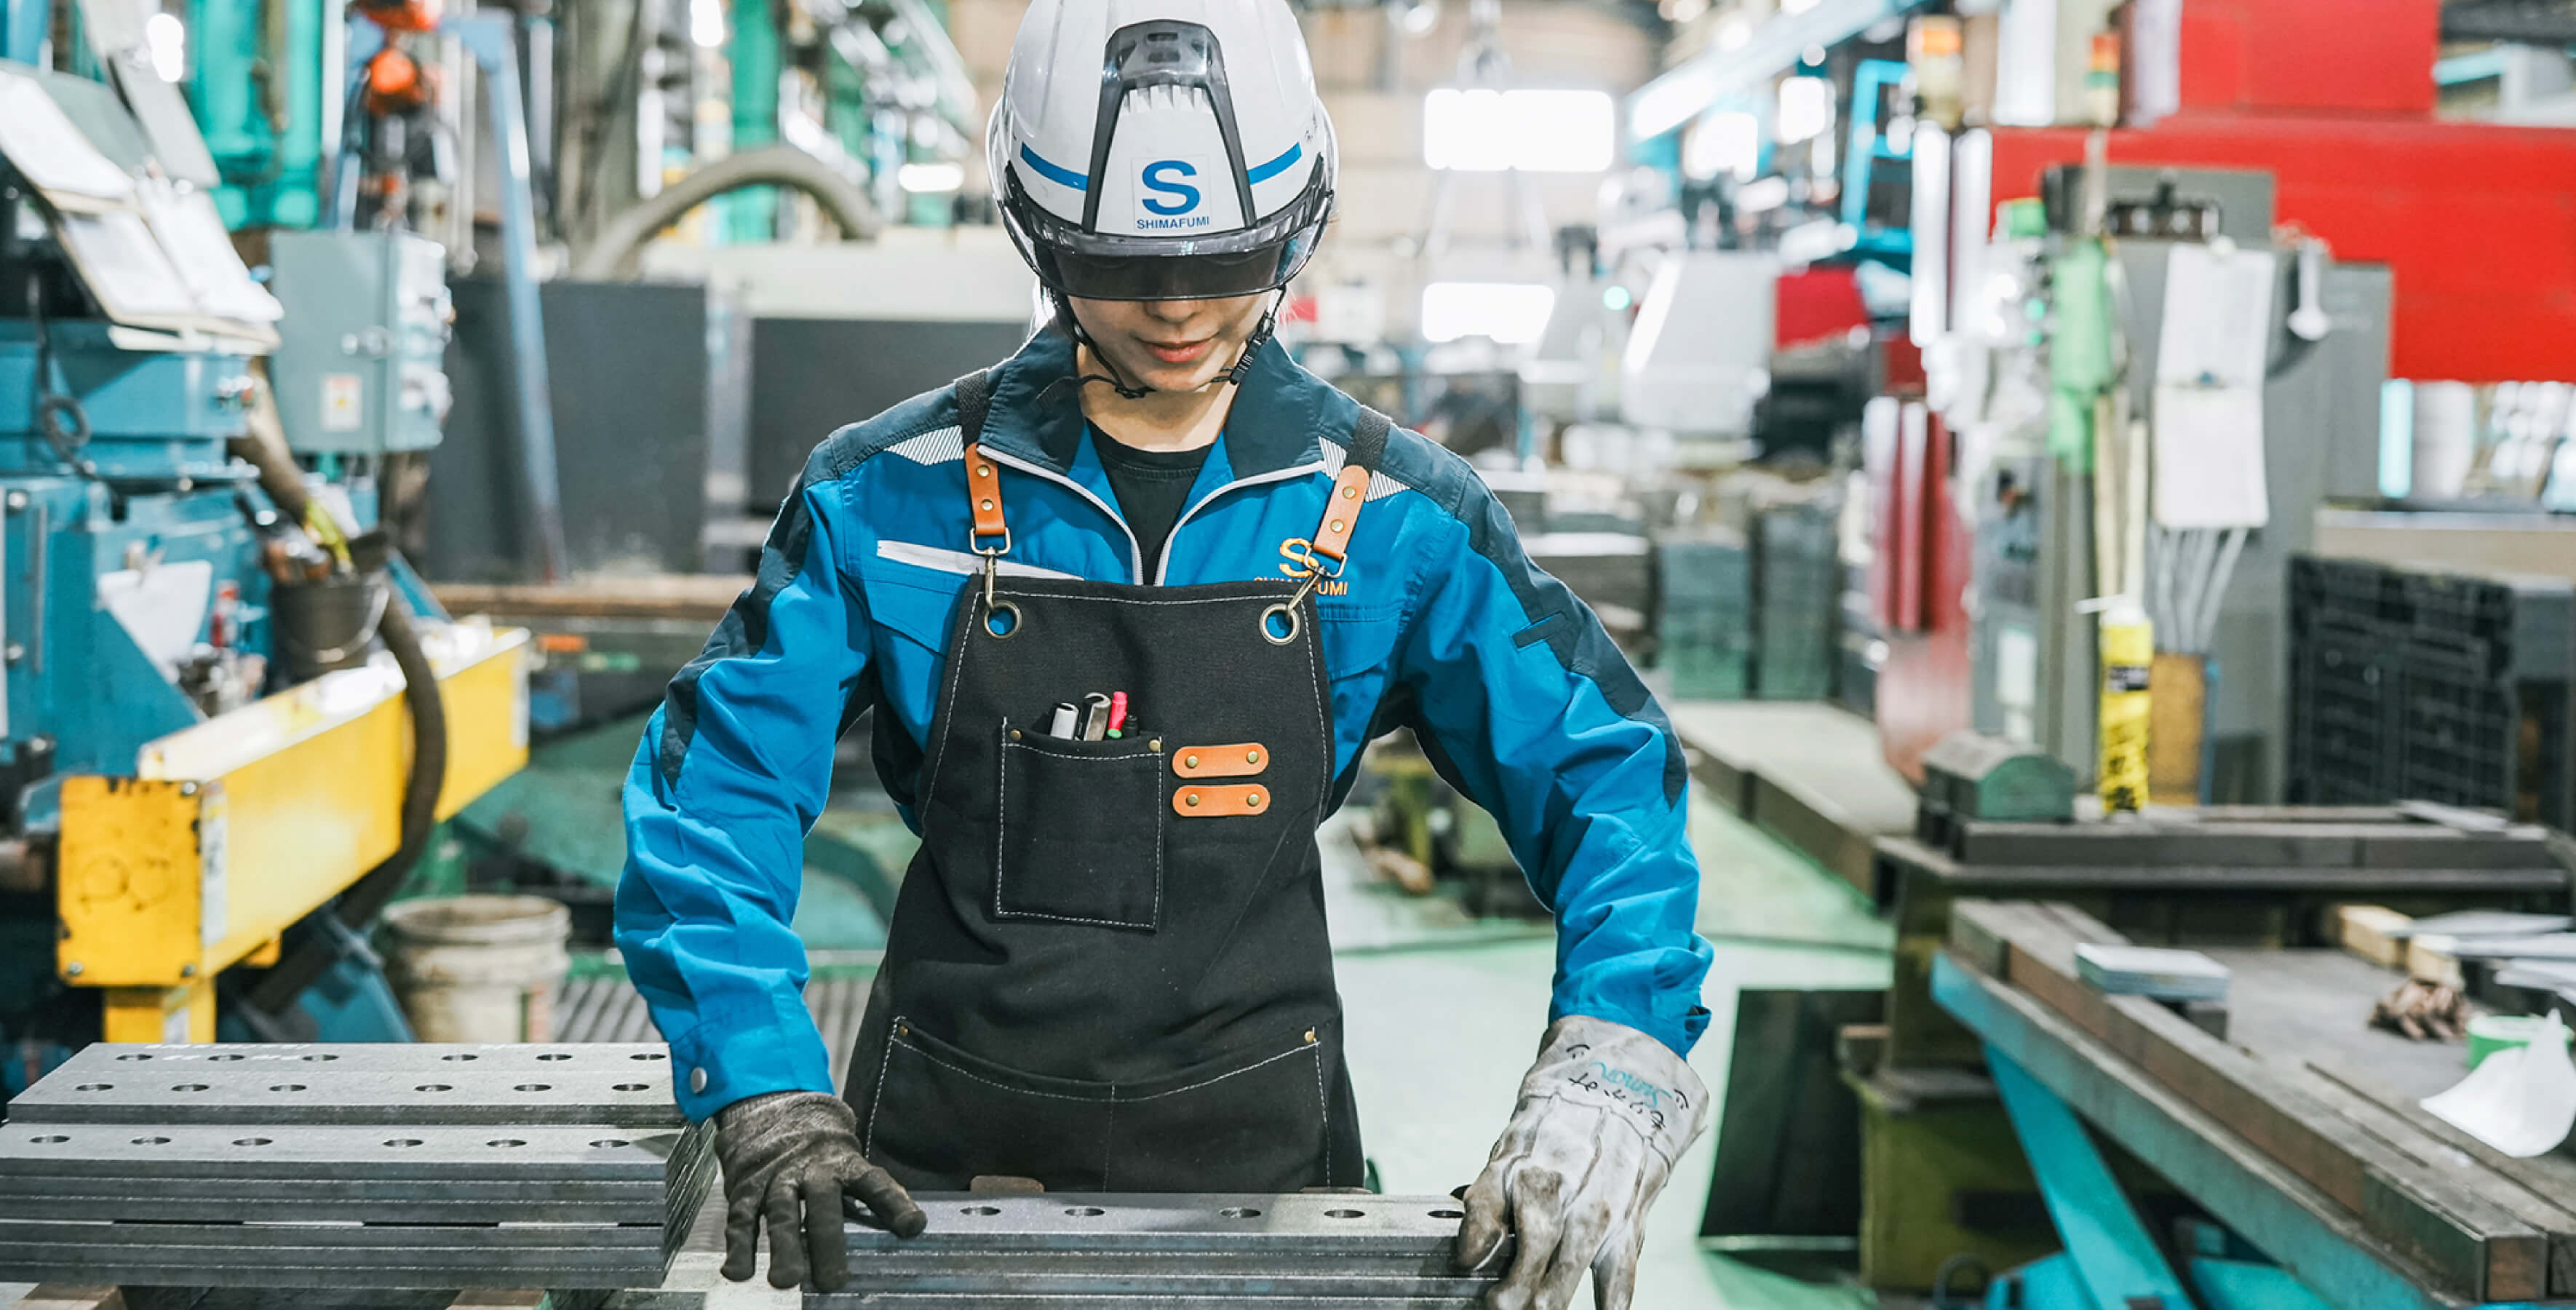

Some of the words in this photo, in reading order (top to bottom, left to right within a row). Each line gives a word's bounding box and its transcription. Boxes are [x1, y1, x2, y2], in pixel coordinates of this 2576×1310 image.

[1142, 160, 1200, 215] S
[1136, 215, 1209, 229] SHIMAFUMI
[1279, 538, 1319, 578] S
